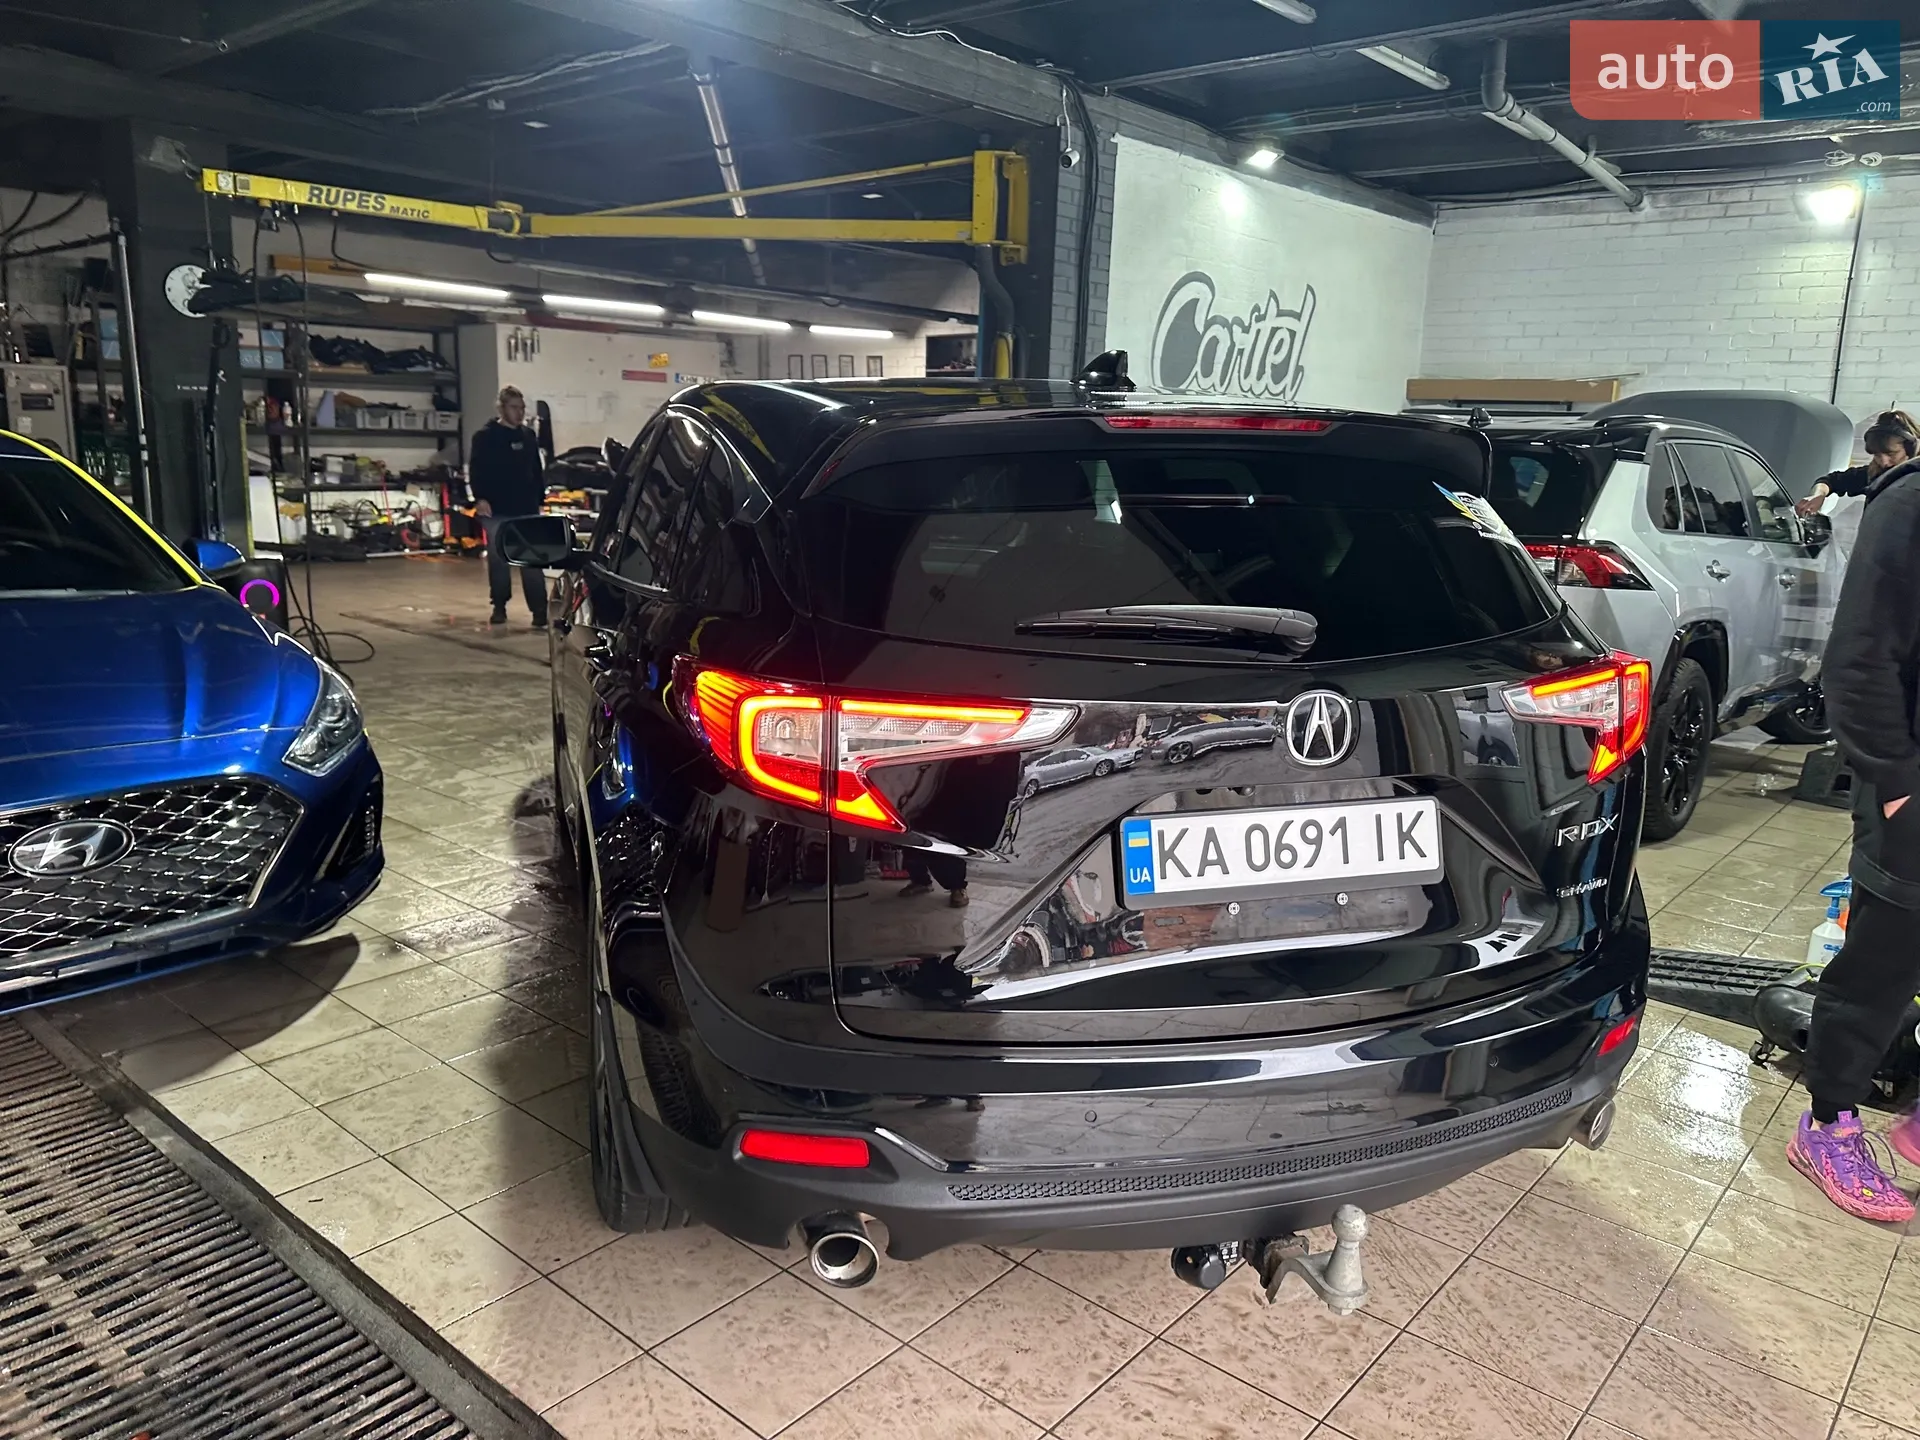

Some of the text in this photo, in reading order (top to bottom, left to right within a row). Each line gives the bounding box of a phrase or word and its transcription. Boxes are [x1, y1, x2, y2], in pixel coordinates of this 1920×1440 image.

[307, 185, 431, 219] RUPES MATIC
[1151, 271, 1316, 400] Cartel
[1157, 810, 1427, 880] KA 0691 IK
[1555, 813, 1619, 847] RDX
[1130, 867, 1152, 884] UA
